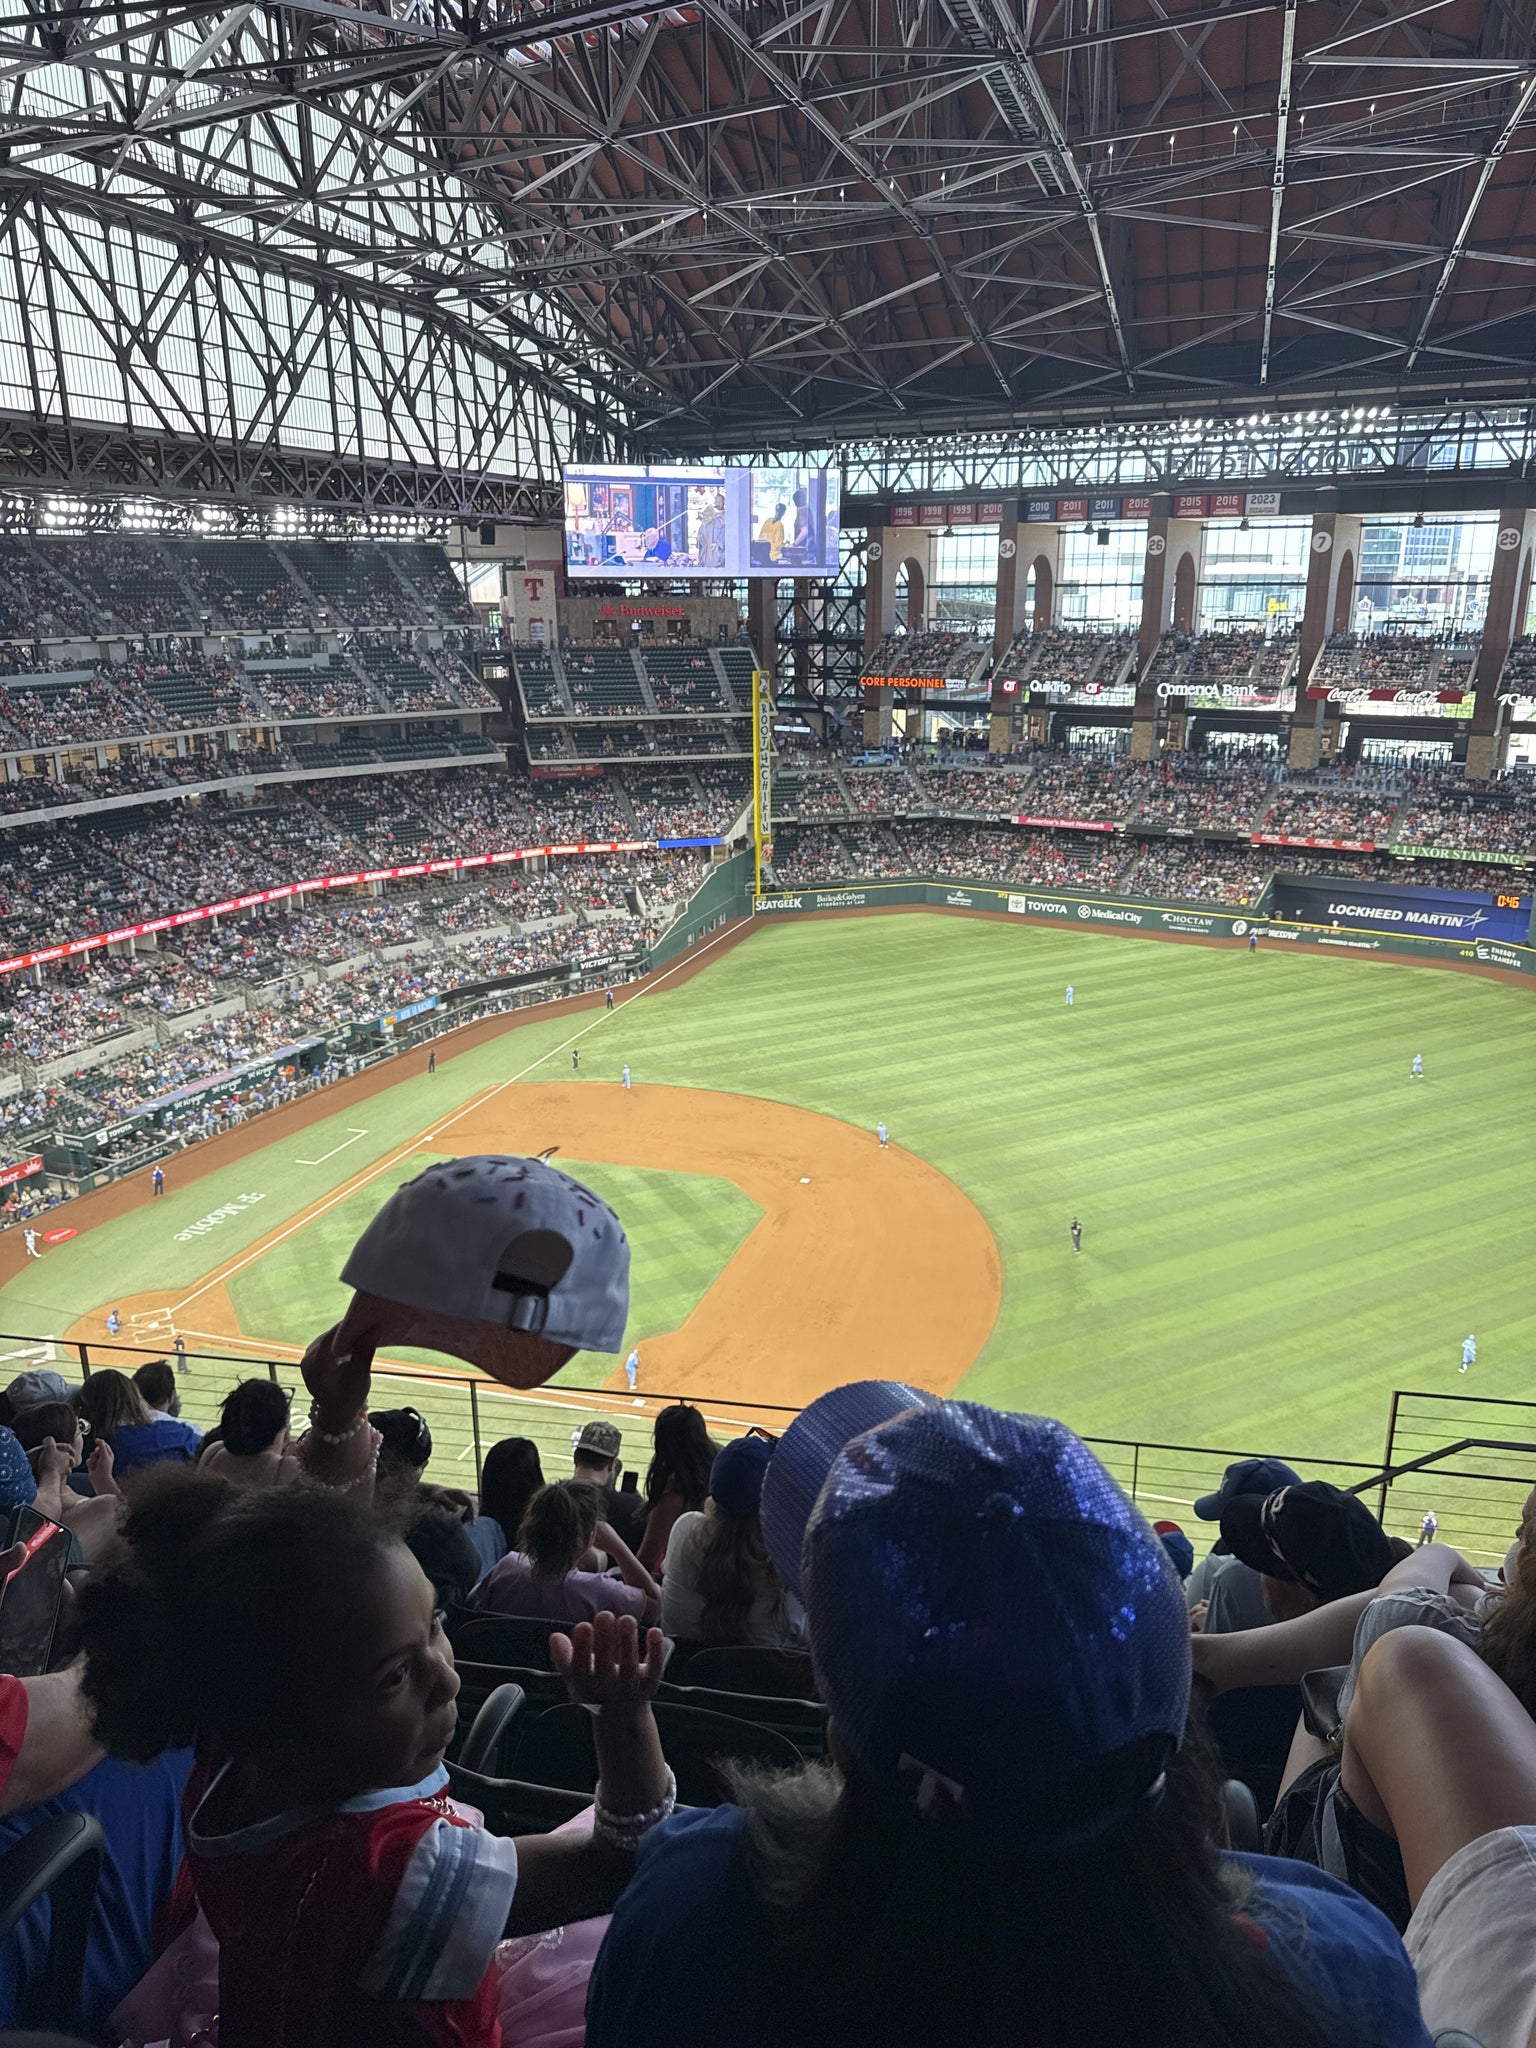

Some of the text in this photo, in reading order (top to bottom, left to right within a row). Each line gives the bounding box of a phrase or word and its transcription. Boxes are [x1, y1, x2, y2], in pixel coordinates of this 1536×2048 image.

[1095, 500, 1113, 510] 2011
[1128, 499, 1149, 509] 2012
[1180, 497, 1201, 507] 2015
[1216, 496, 1238, 506] 2016
[1250, 495, 1275, 505] 2023
[895, 507, 912, 516] 1996
[924, 506, 942, 515] 1998
[953, 505, 971, 514] 1999
[983, 504, 1003, 514] 2010
[1030, 502, 1049, 512] 2010
[1063, 502, 1081, 511] 2011
[1149, 539, 1163, 550] 26
[1318, 536, 1327, 548] 7
[1500, 533, 1517, 546] 29
[868, 546, 881, 557] 42
[1001, 543, 1014, 554] 34
[523, 578, 543, 601] T
[620, 604, 684, 616] Budweiser
[860, 676, 945, 689] CORE PERSONNEL
[1030, 680, 1071, 694] QuikTrip
[1223, 684, 1259, 697] Bank
[761, 703, 769, 747] ROOT
[1026, 817, 1058, 826] America's
[1402, 845, 1520, 864] LUXOR STAFFING
[755, 898, 802, 911] SEATGEEK
[1027, 901, 1068, 914] TOYOTA
[1497, 895, 1520, 908] 0:46
[1092, 909, 1143, 924] Medical City
[1166, 913, 1213, 926] CHOCTAW
[1328, 903, 1463, 927] LOCKHEED MARTIN
[1491, 947, 1517, 958] ENERGY
[580, 957, 613, 970] VICTORY
[1491, 954, 1522, 967] TRANSFER
[109, 1123, 133, 1137] TOYOTA
[173, 1203, 249, 1241] Mobile
